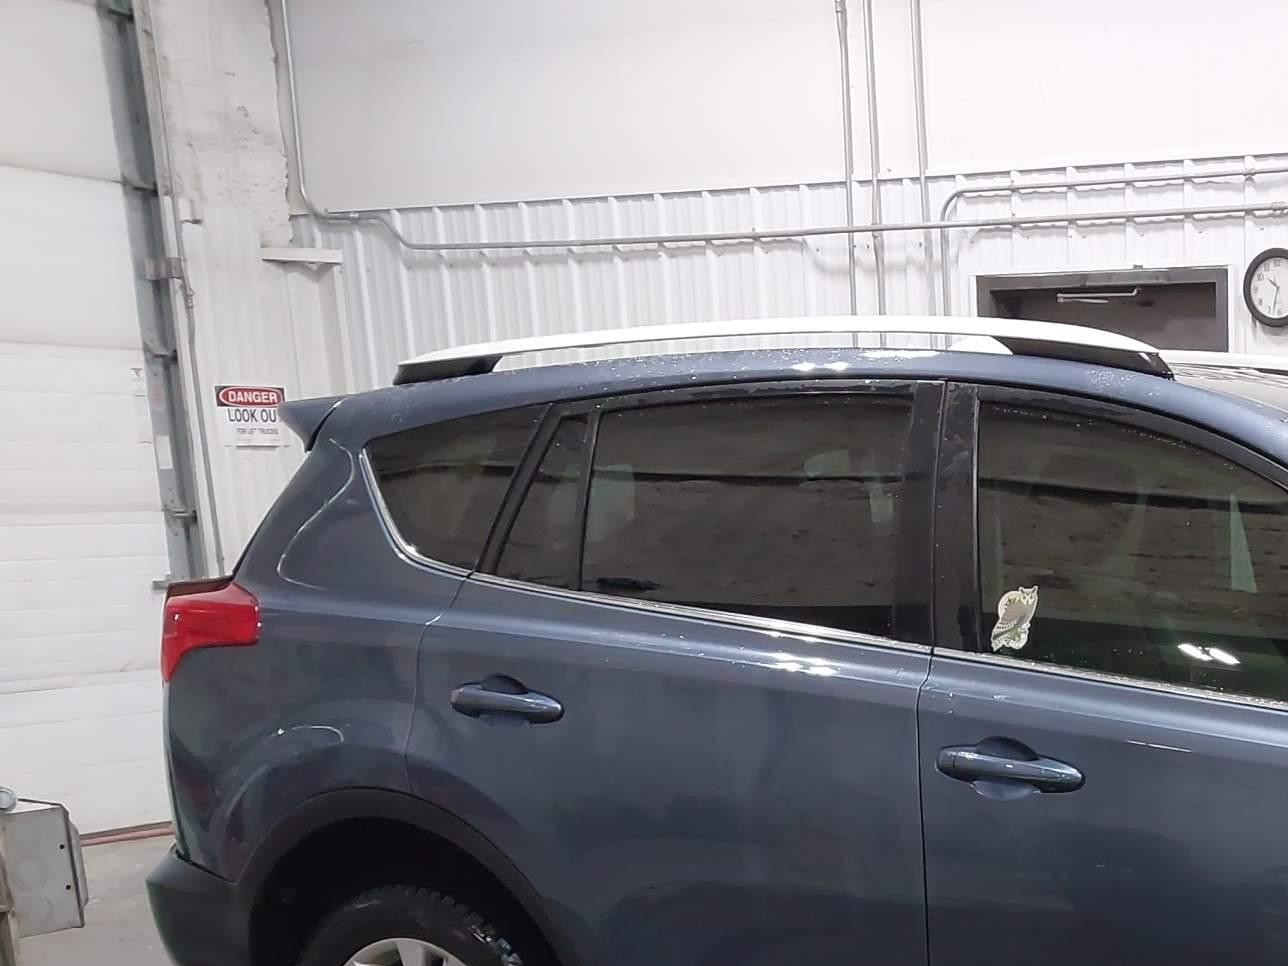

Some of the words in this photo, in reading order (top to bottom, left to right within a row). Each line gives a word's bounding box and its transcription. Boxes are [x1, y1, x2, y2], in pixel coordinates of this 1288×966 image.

[228, 391, 278, 403] DANGER
[227, 408, 258, 422] LOOK
[260, 409, 278, 423] OU
